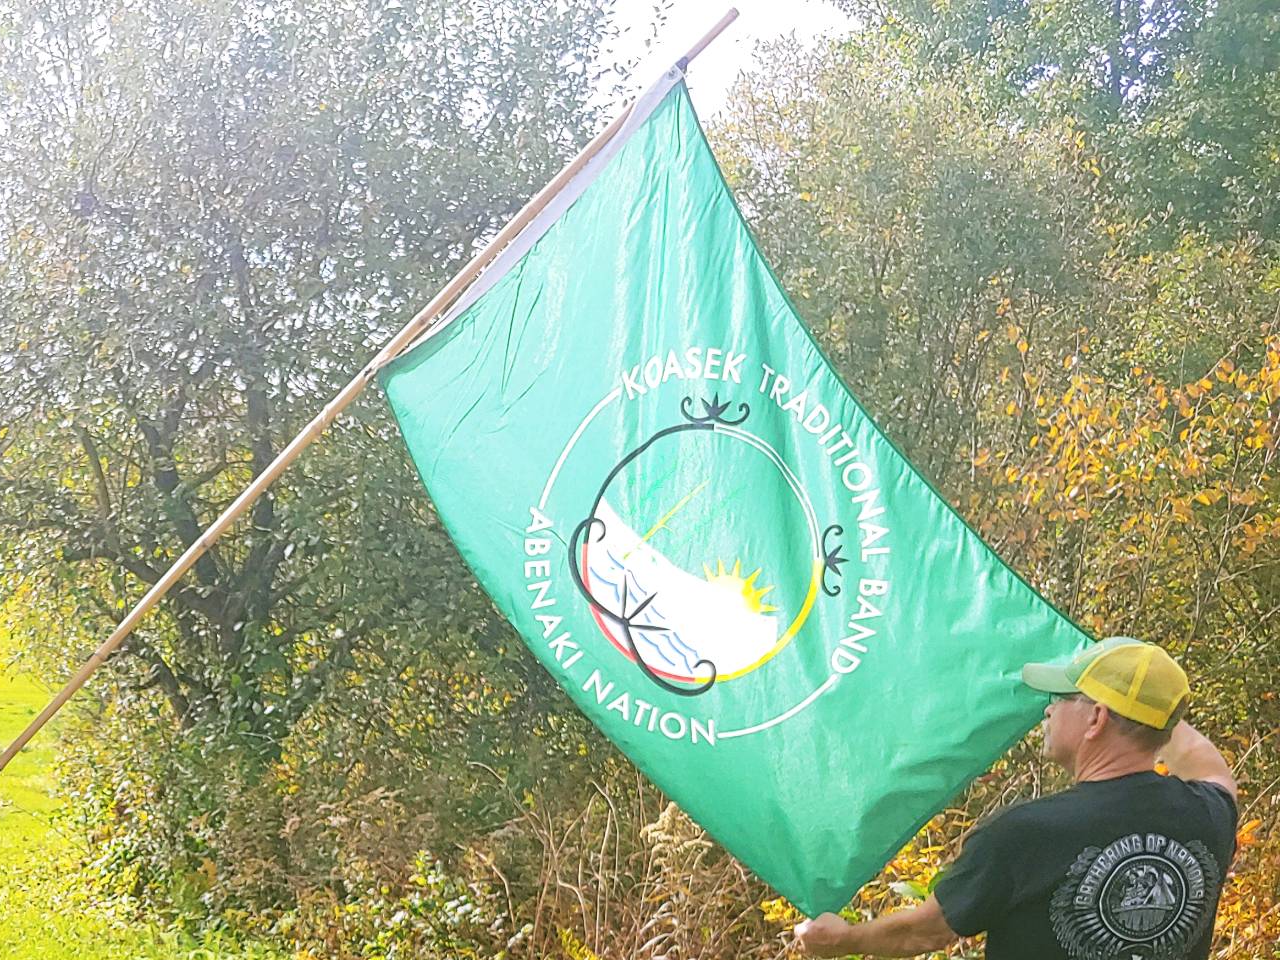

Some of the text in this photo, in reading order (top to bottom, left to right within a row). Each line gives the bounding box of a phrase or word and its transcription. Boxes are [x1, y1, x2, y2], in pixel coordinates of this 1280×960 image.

[524, 507, 715, 746] ABENAKI NATION
[621, 347, 890, 675] KOASEK TRADITIONAL BAND
[1075, 834, 1204, 906] GATHERING OF NATIONS
